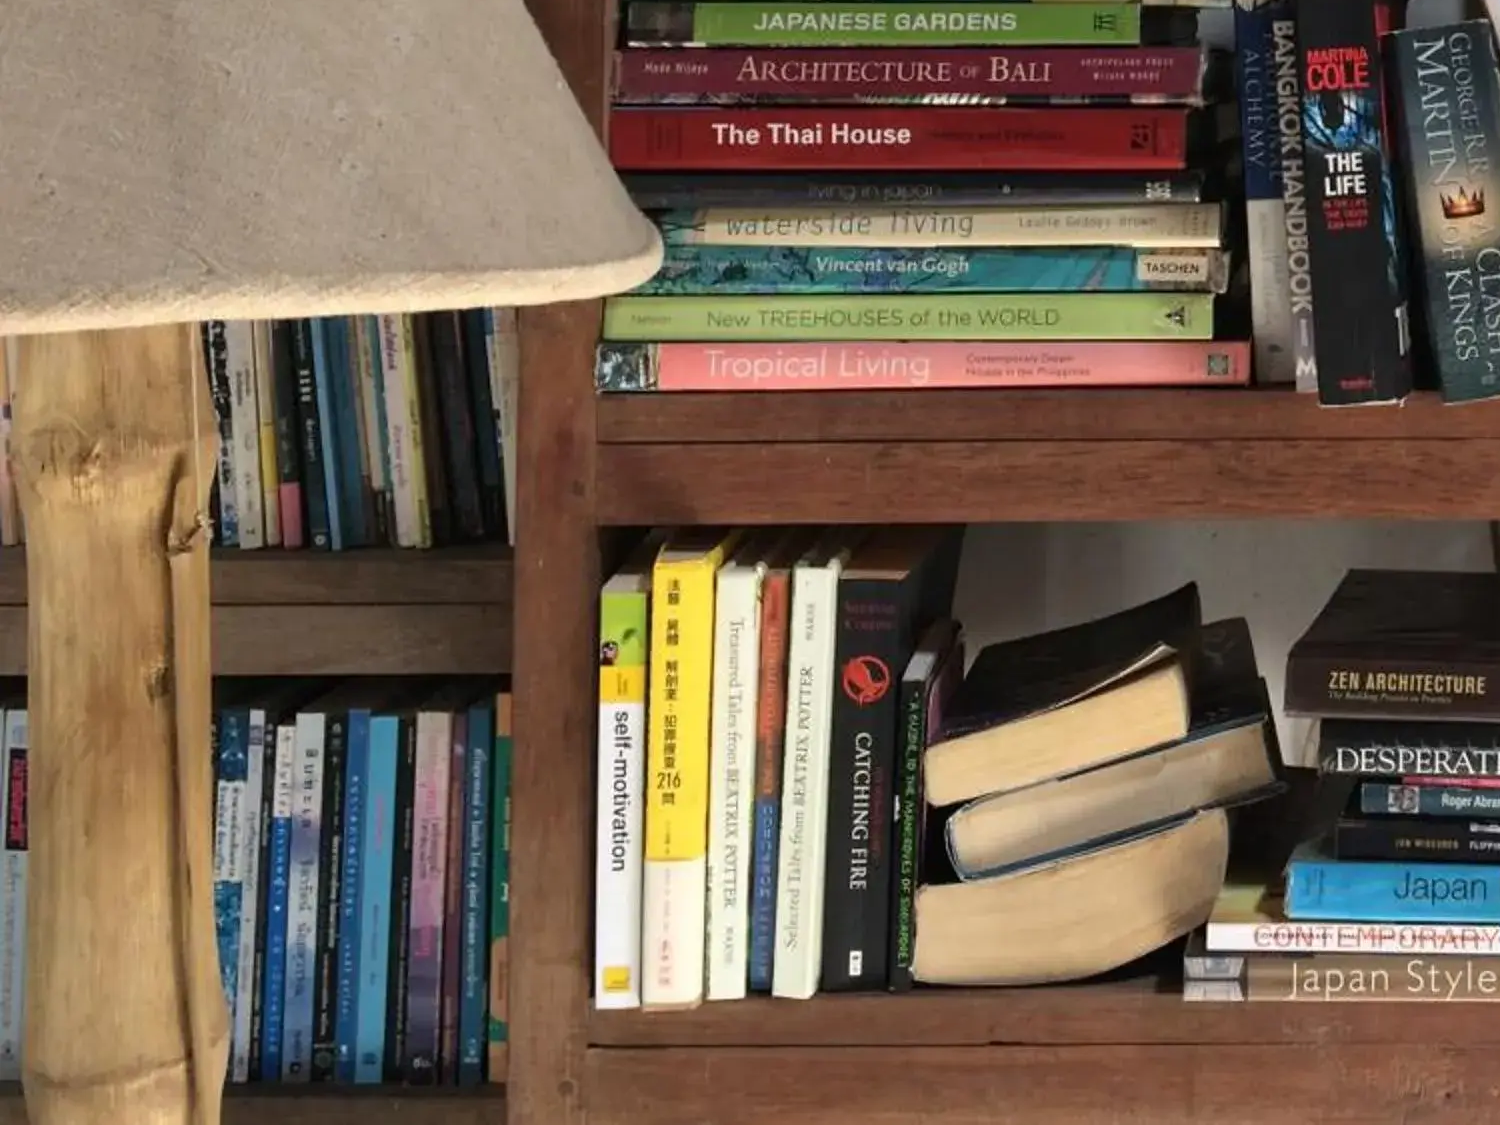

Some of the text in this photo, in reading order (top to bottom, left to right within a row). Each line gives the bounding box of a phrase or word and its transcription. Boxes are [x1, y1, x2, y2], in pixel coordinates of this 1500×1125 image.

[753, 13, 1018, 31] JAPANESE GARDENS
[736, 55, 1053, 83] ARCHITECTURE OF BALI
[1306, 46, 1369, 65] MARTINA
[1306, 63, 1370, 91] COLE
[1449, 31, 1481, 130] GEORGE
[1243, 49, 1265, 167] ALCHEMY
[1413, 35, 1458, 186] MARTIN
[712, 122, 760, 146] The
[767, 122, 823, 146] Thai
[830, 122, 912, 146] House
[1273, 19, 1313, 314] BANGKOK HANDBOOK
[1324, 151, 1364, 173] THE
[1324, 174, 1368, 197] LIFE
[726, 211, 974, 238] waterside living
[815, 256, 970, 277] Vincent van Gogh
[1146, 262, 1201, 275] TASCHEN
[706, 307, 1061, 327] New TREEHOUSES of the WORLD
[1444, 268, 1480, 362] KINGS
[704, 349, 931, 385] Tropical Living
[796, 665, 814, 732] POTTER
[1329, 672, 1487, 695] ZEN ARCHITECTURE
[725, 730, 741, 767] from
[656, 772, 682, 790] 216
[792, 735, 810, 806] BEATRIX
[611, 711, 633, 873] self-motivation
[724, 768, 740, 839] BEATRIX
[1440, 793, 1473, 810] Roger
[788, 809, 805, 845] from
[849, 732, 872, 891] CATCHING FIRE
[722, 843, 738, 910] POTTER
[1393, 870, 1488, 907] Japan
[782, 886, 801, 952] Selected
[1290, 960, 1498, 1001] Japan Style
